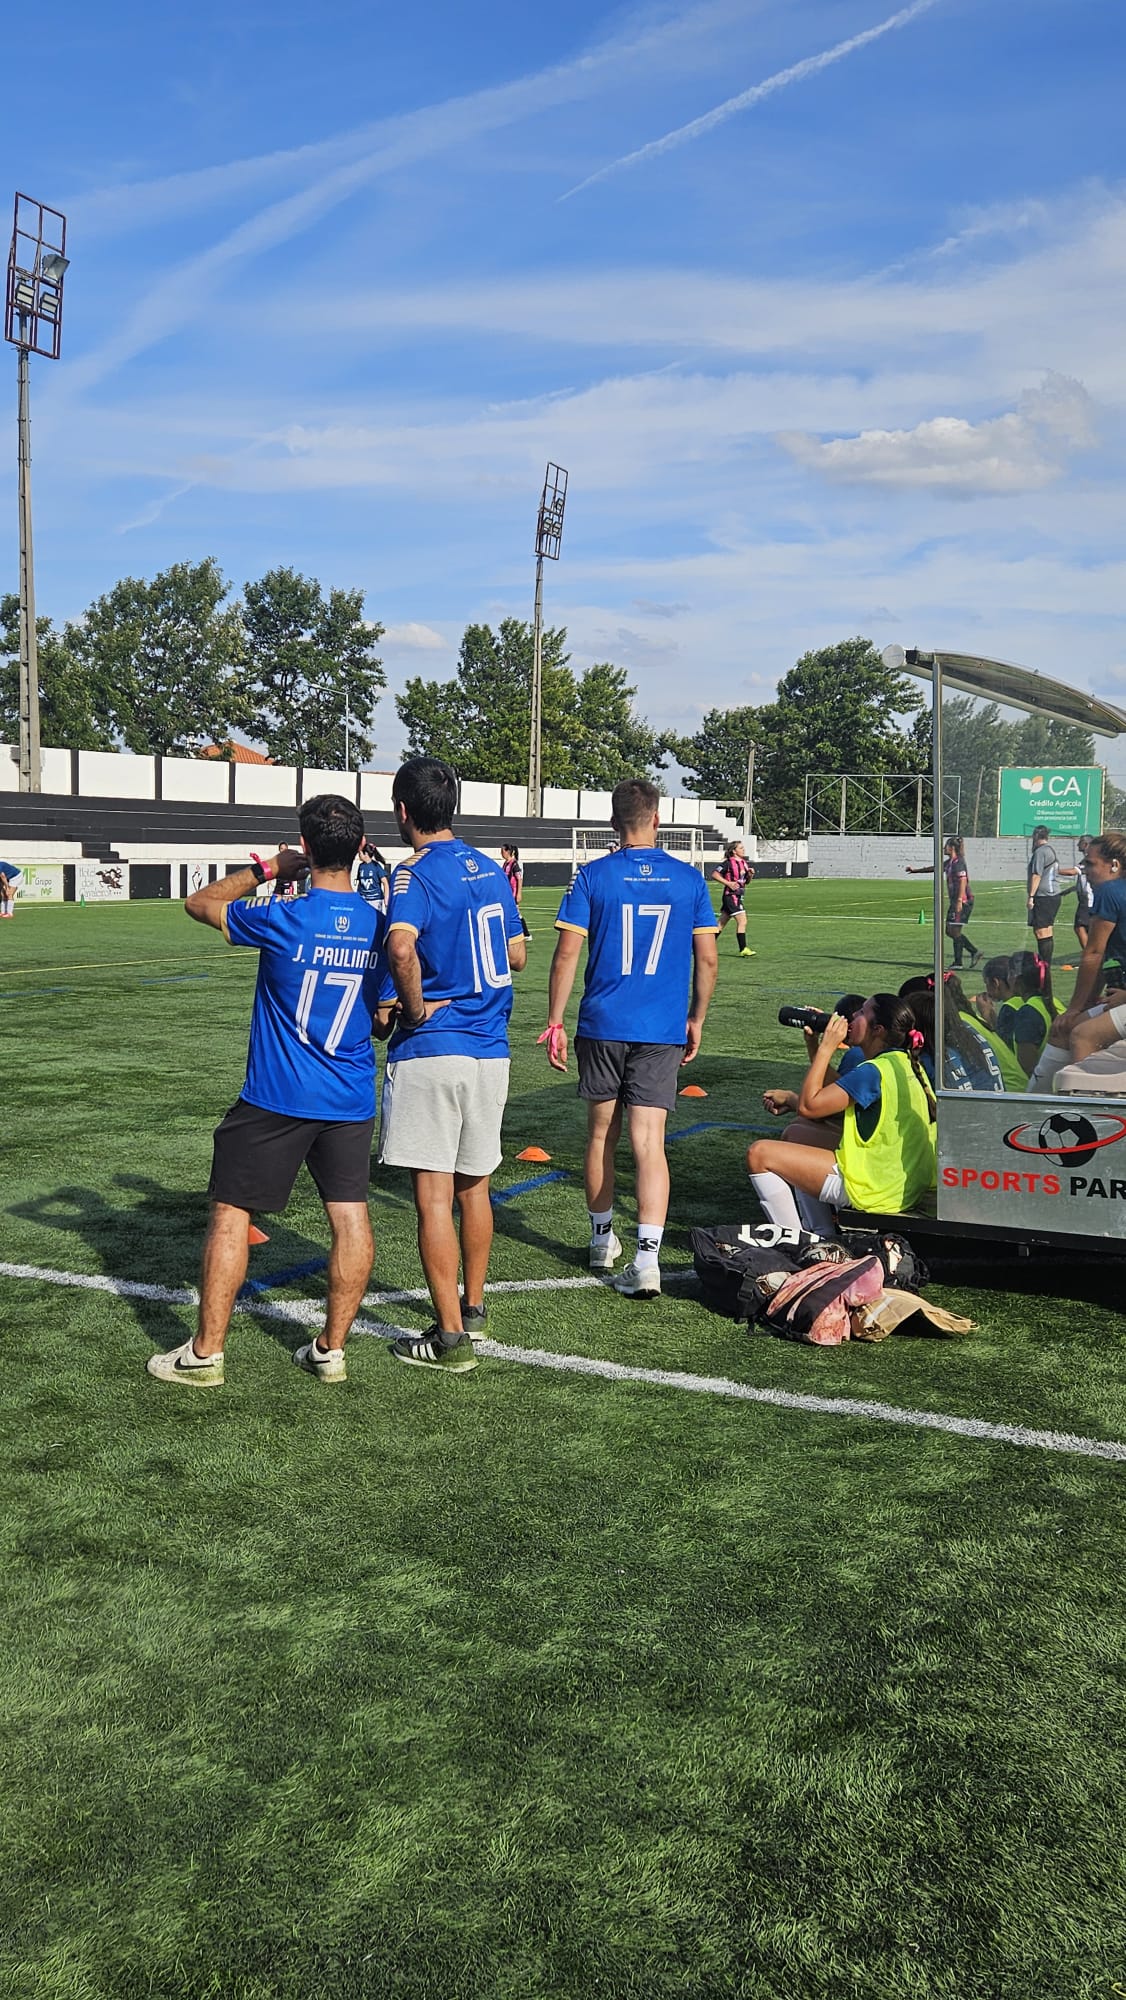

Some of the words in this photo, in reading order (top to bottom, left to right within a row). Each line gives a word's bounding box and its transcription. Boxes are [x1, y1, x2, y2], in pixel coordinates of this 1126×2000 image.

[1048, 775, 1082, 796] CA
[1029, 799, 1054, 807] Crédito
[1055, 799, 1082, 808] Agrícola
[35, 877, 52, 887] Grupo
[292, 943, 306, 963] J.
[467, 902, 513, 994] 10
[621, 903, 672, 976] 17
[295, 969, 363, 1056] 17
[942, 1167, 1061, 1195] SPORTS
[1070, 1176, 1126, 1200] PAR
